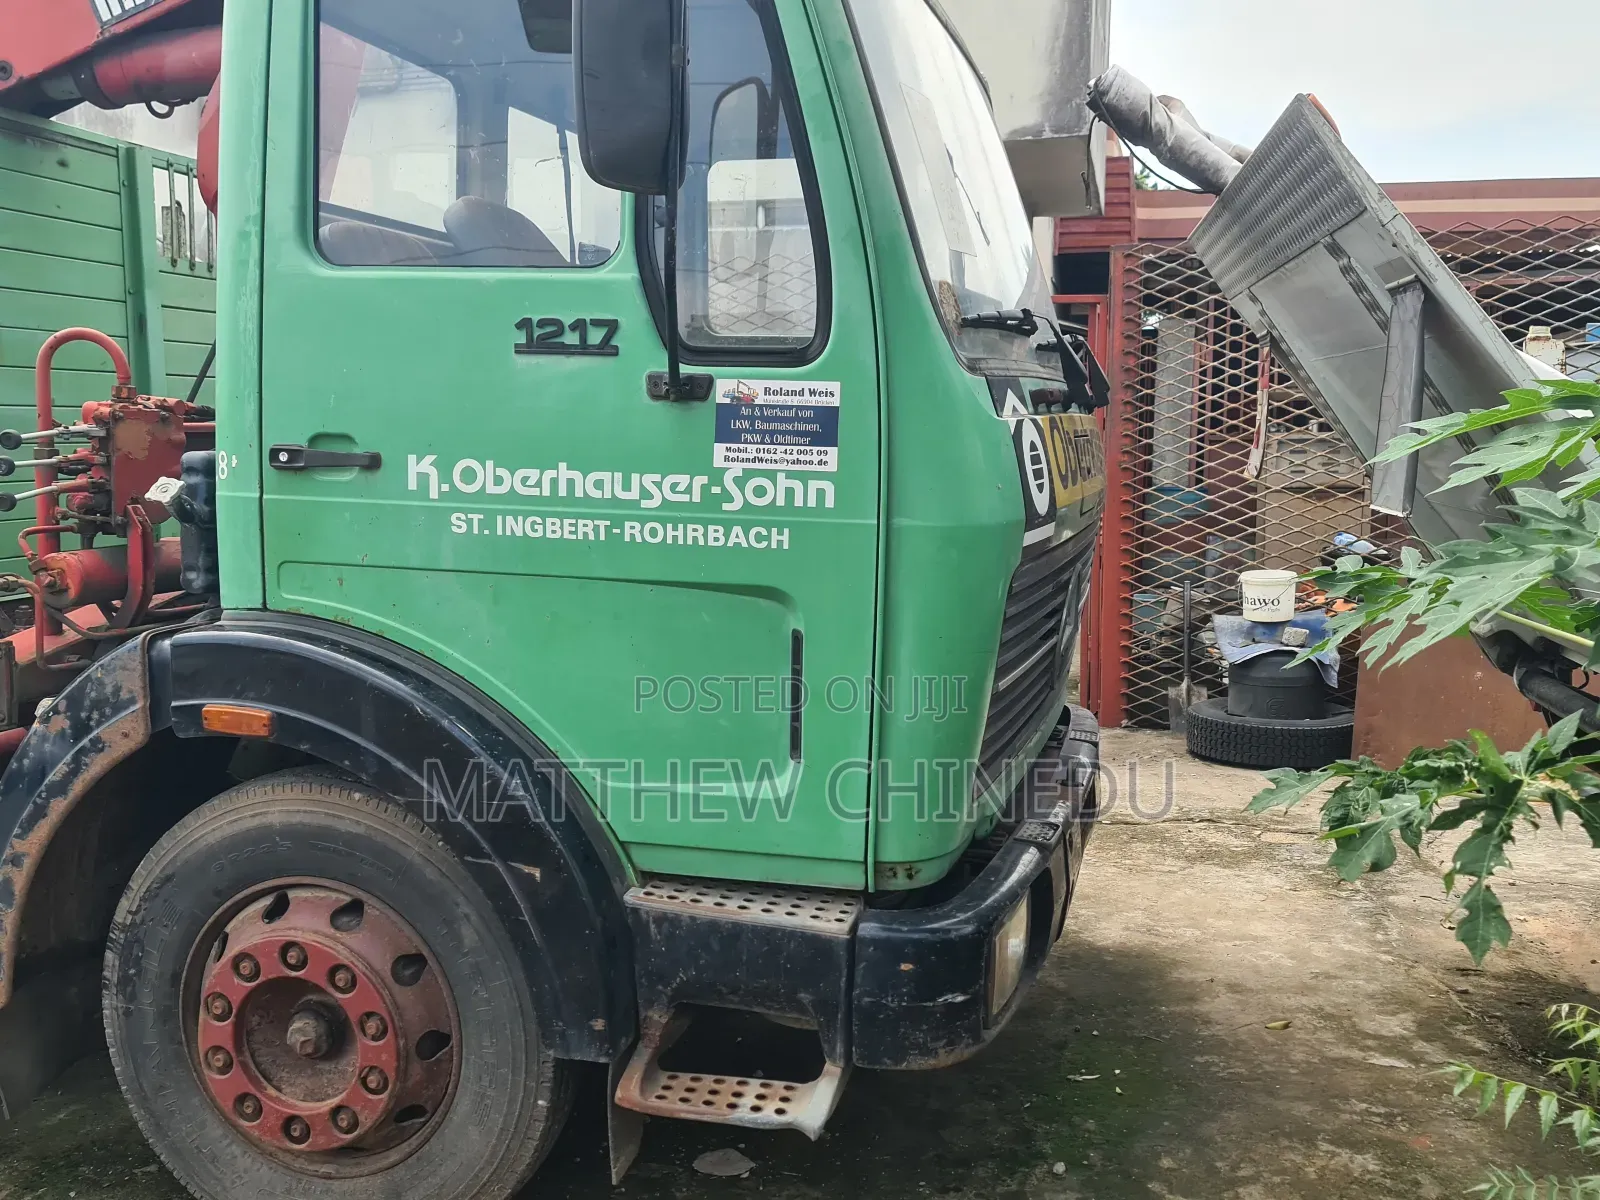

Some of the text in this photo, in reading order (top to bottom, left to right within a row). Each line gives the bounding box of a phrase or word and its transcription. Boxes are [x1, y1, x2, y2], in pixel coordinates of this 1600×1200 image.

[514, 317, 619, 351] 1217
[763, 386, 835, 398] Roland Weis
[740, 406, 814, 418] An & Verkauf von
[731, 419, 822, 433] LKW, Baumaschinen,
[741, 433, 811, 445] PKW & Oldtimer
[755, 447, 778, 455] 0162
[796, 448, 814, 456] 005
[817, 449, 829, 457] 09
[723, 455, 829, 467] RolandWeis@yahoo.de
[450, 512, 790, 550] ST. INGBERT-ROHRBACH
